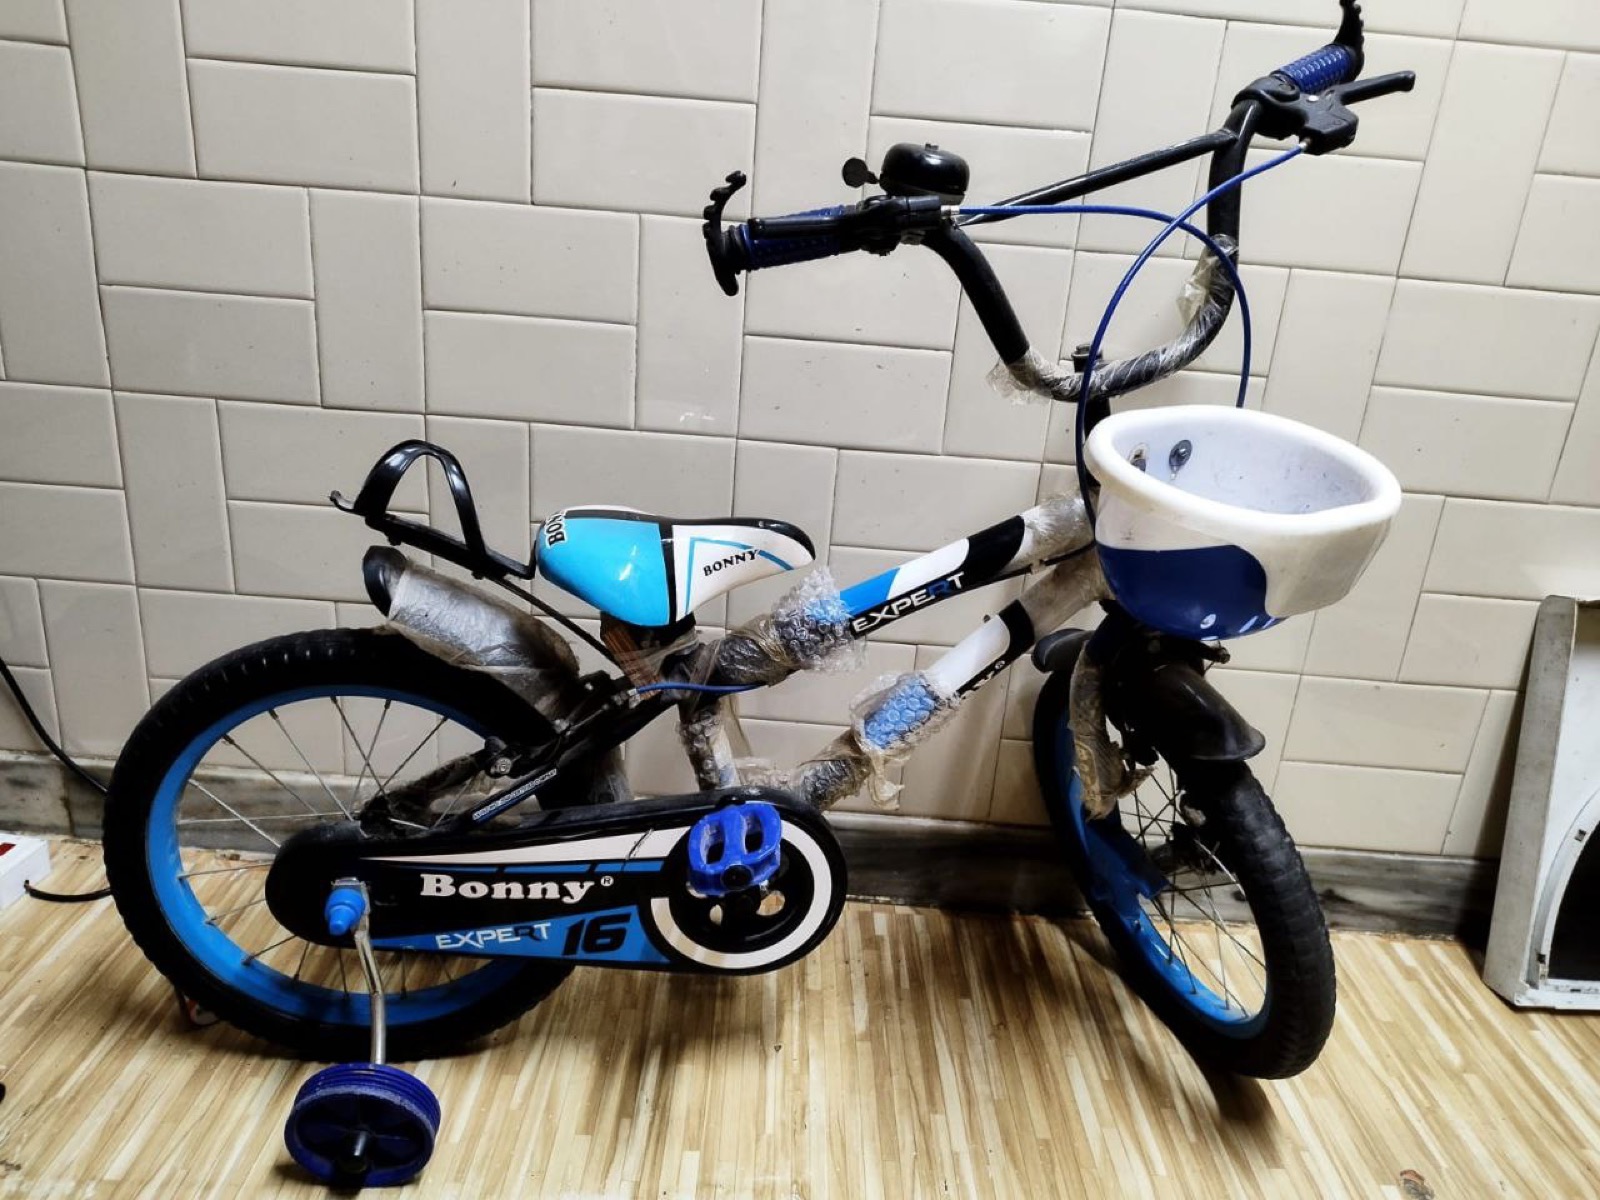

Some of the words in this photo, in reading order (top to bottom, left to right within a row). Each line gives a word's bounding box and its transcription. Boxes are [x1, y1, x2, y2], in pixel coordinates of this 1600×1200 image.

[703, 549, 758, 577] BONNY
[852, 571, 965, 633] EXPERT
[435, 922, 551, 950] EXPERT
[562, 913, 632, 956] 16
